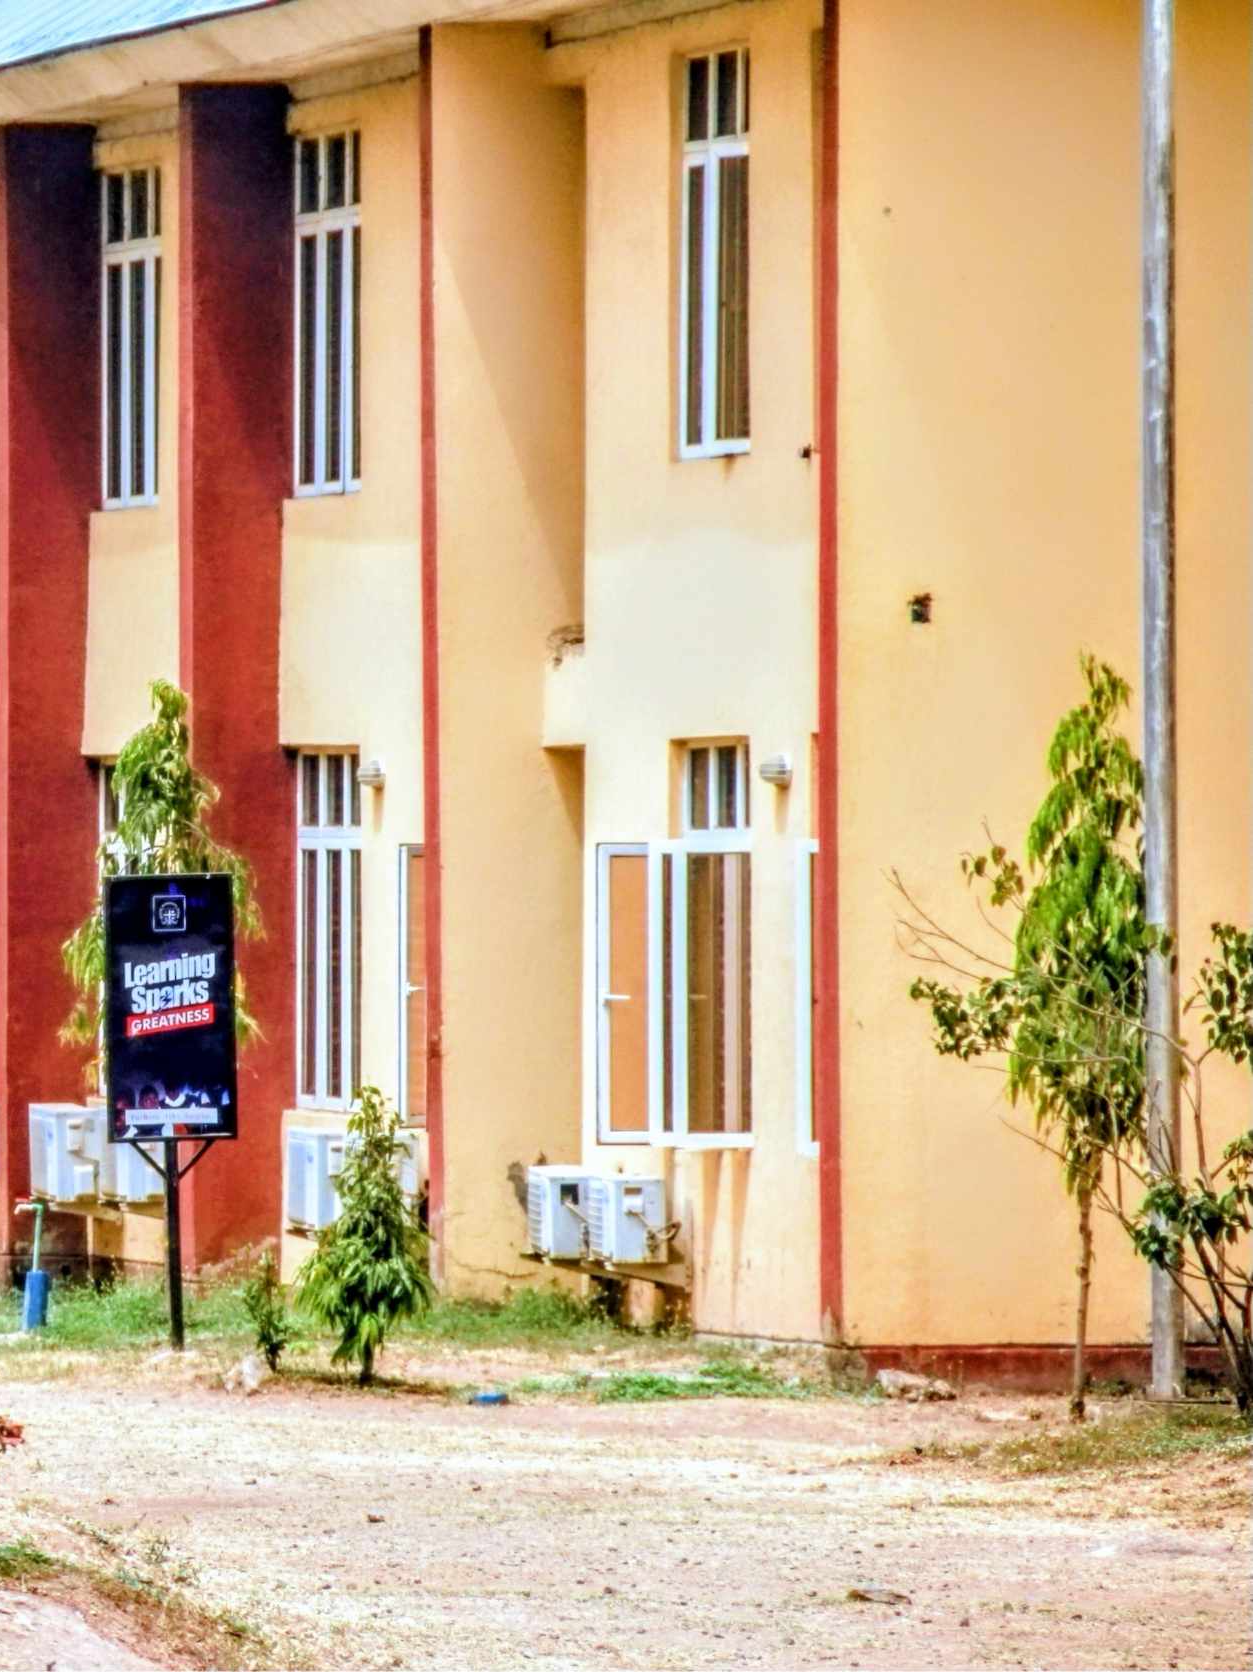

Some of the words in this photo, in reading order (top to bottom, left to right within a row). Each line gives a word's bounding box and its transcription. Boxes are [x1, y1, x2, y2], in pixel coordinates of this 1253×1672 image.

[124, 953, 216, 988] Learning
[132, 979, 209, 1014] Sparks
[131, 1008, 210, 1031] GREATNESS
